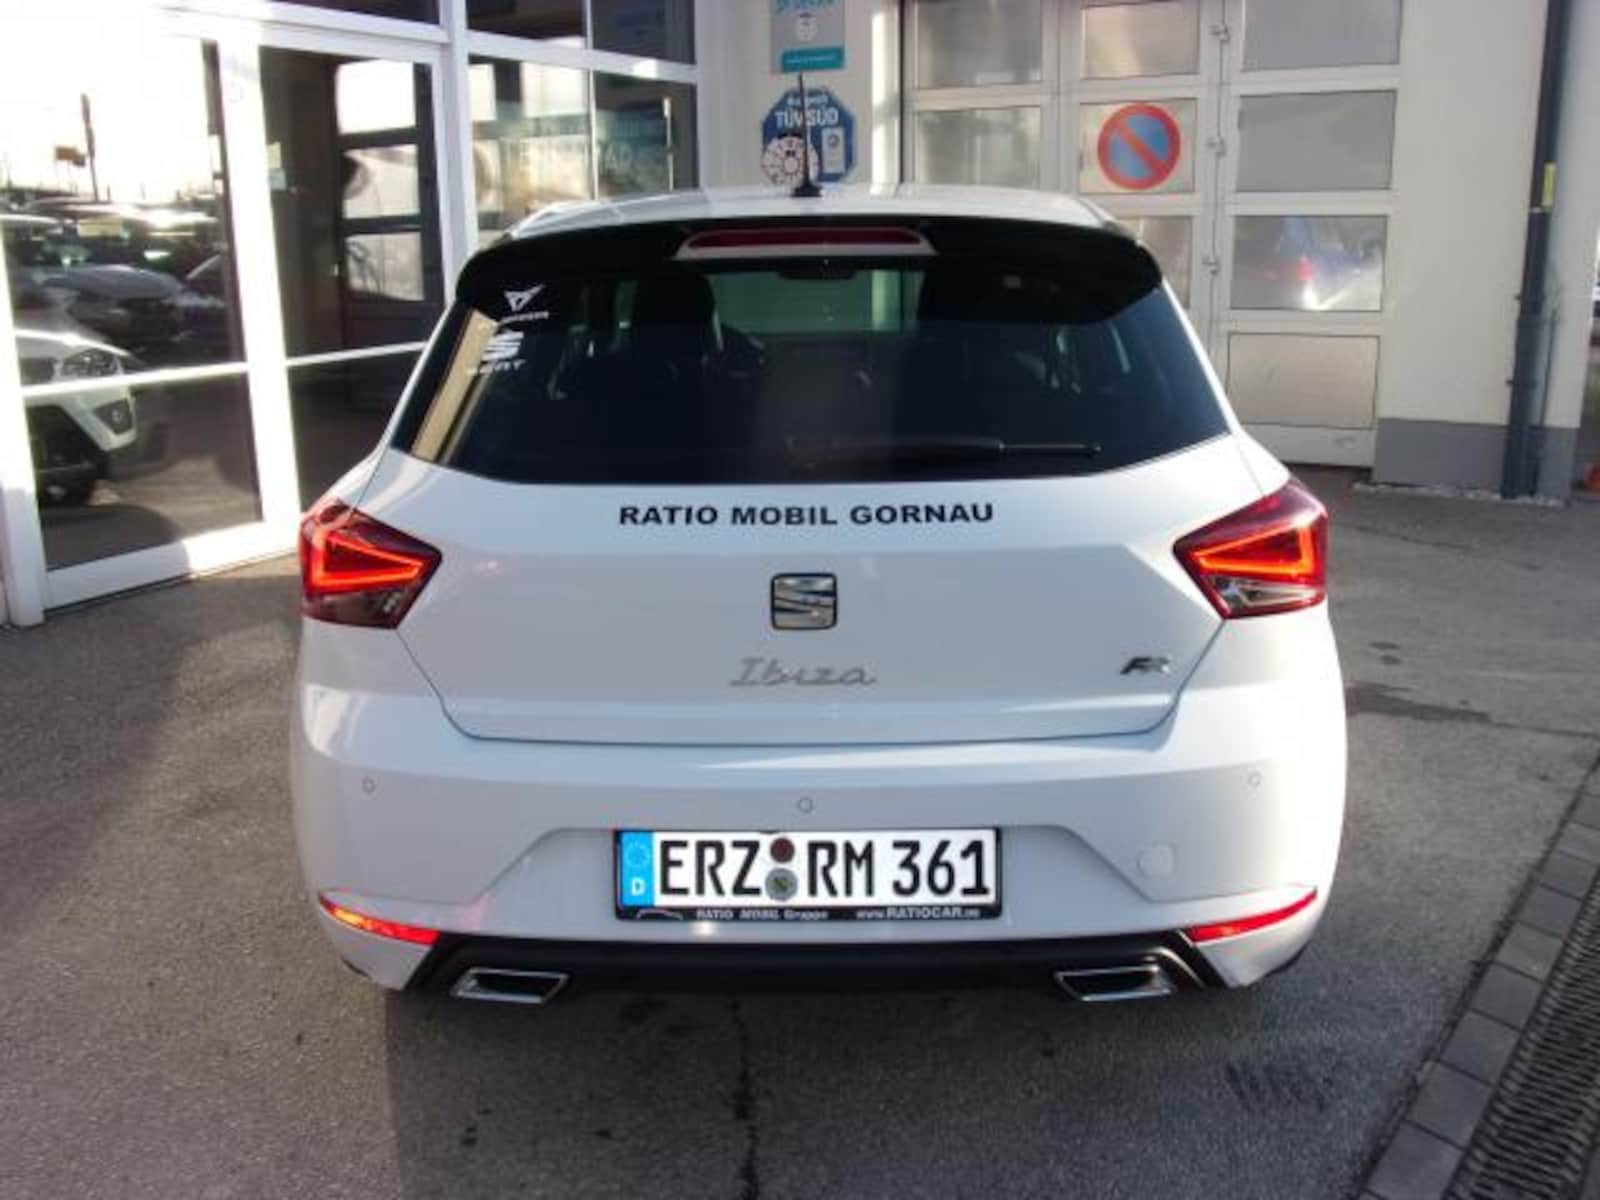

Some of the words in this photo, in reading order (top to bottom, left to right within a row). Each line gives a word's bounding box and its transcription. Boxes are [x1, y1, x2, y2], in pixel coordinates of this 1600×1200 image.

[619, 506, 718, 526] RATIO
[731, 506, 837, 525] MOBIL
[850, 504, 993, 523] GORNAU
[729, 656, 877, 687] Ibiza
[659, 839, 763, 896] ERZ
[806, 839, 875, 897] RM
[891, 839, 991, 896] 361
[631, 877, 645, 896] D
